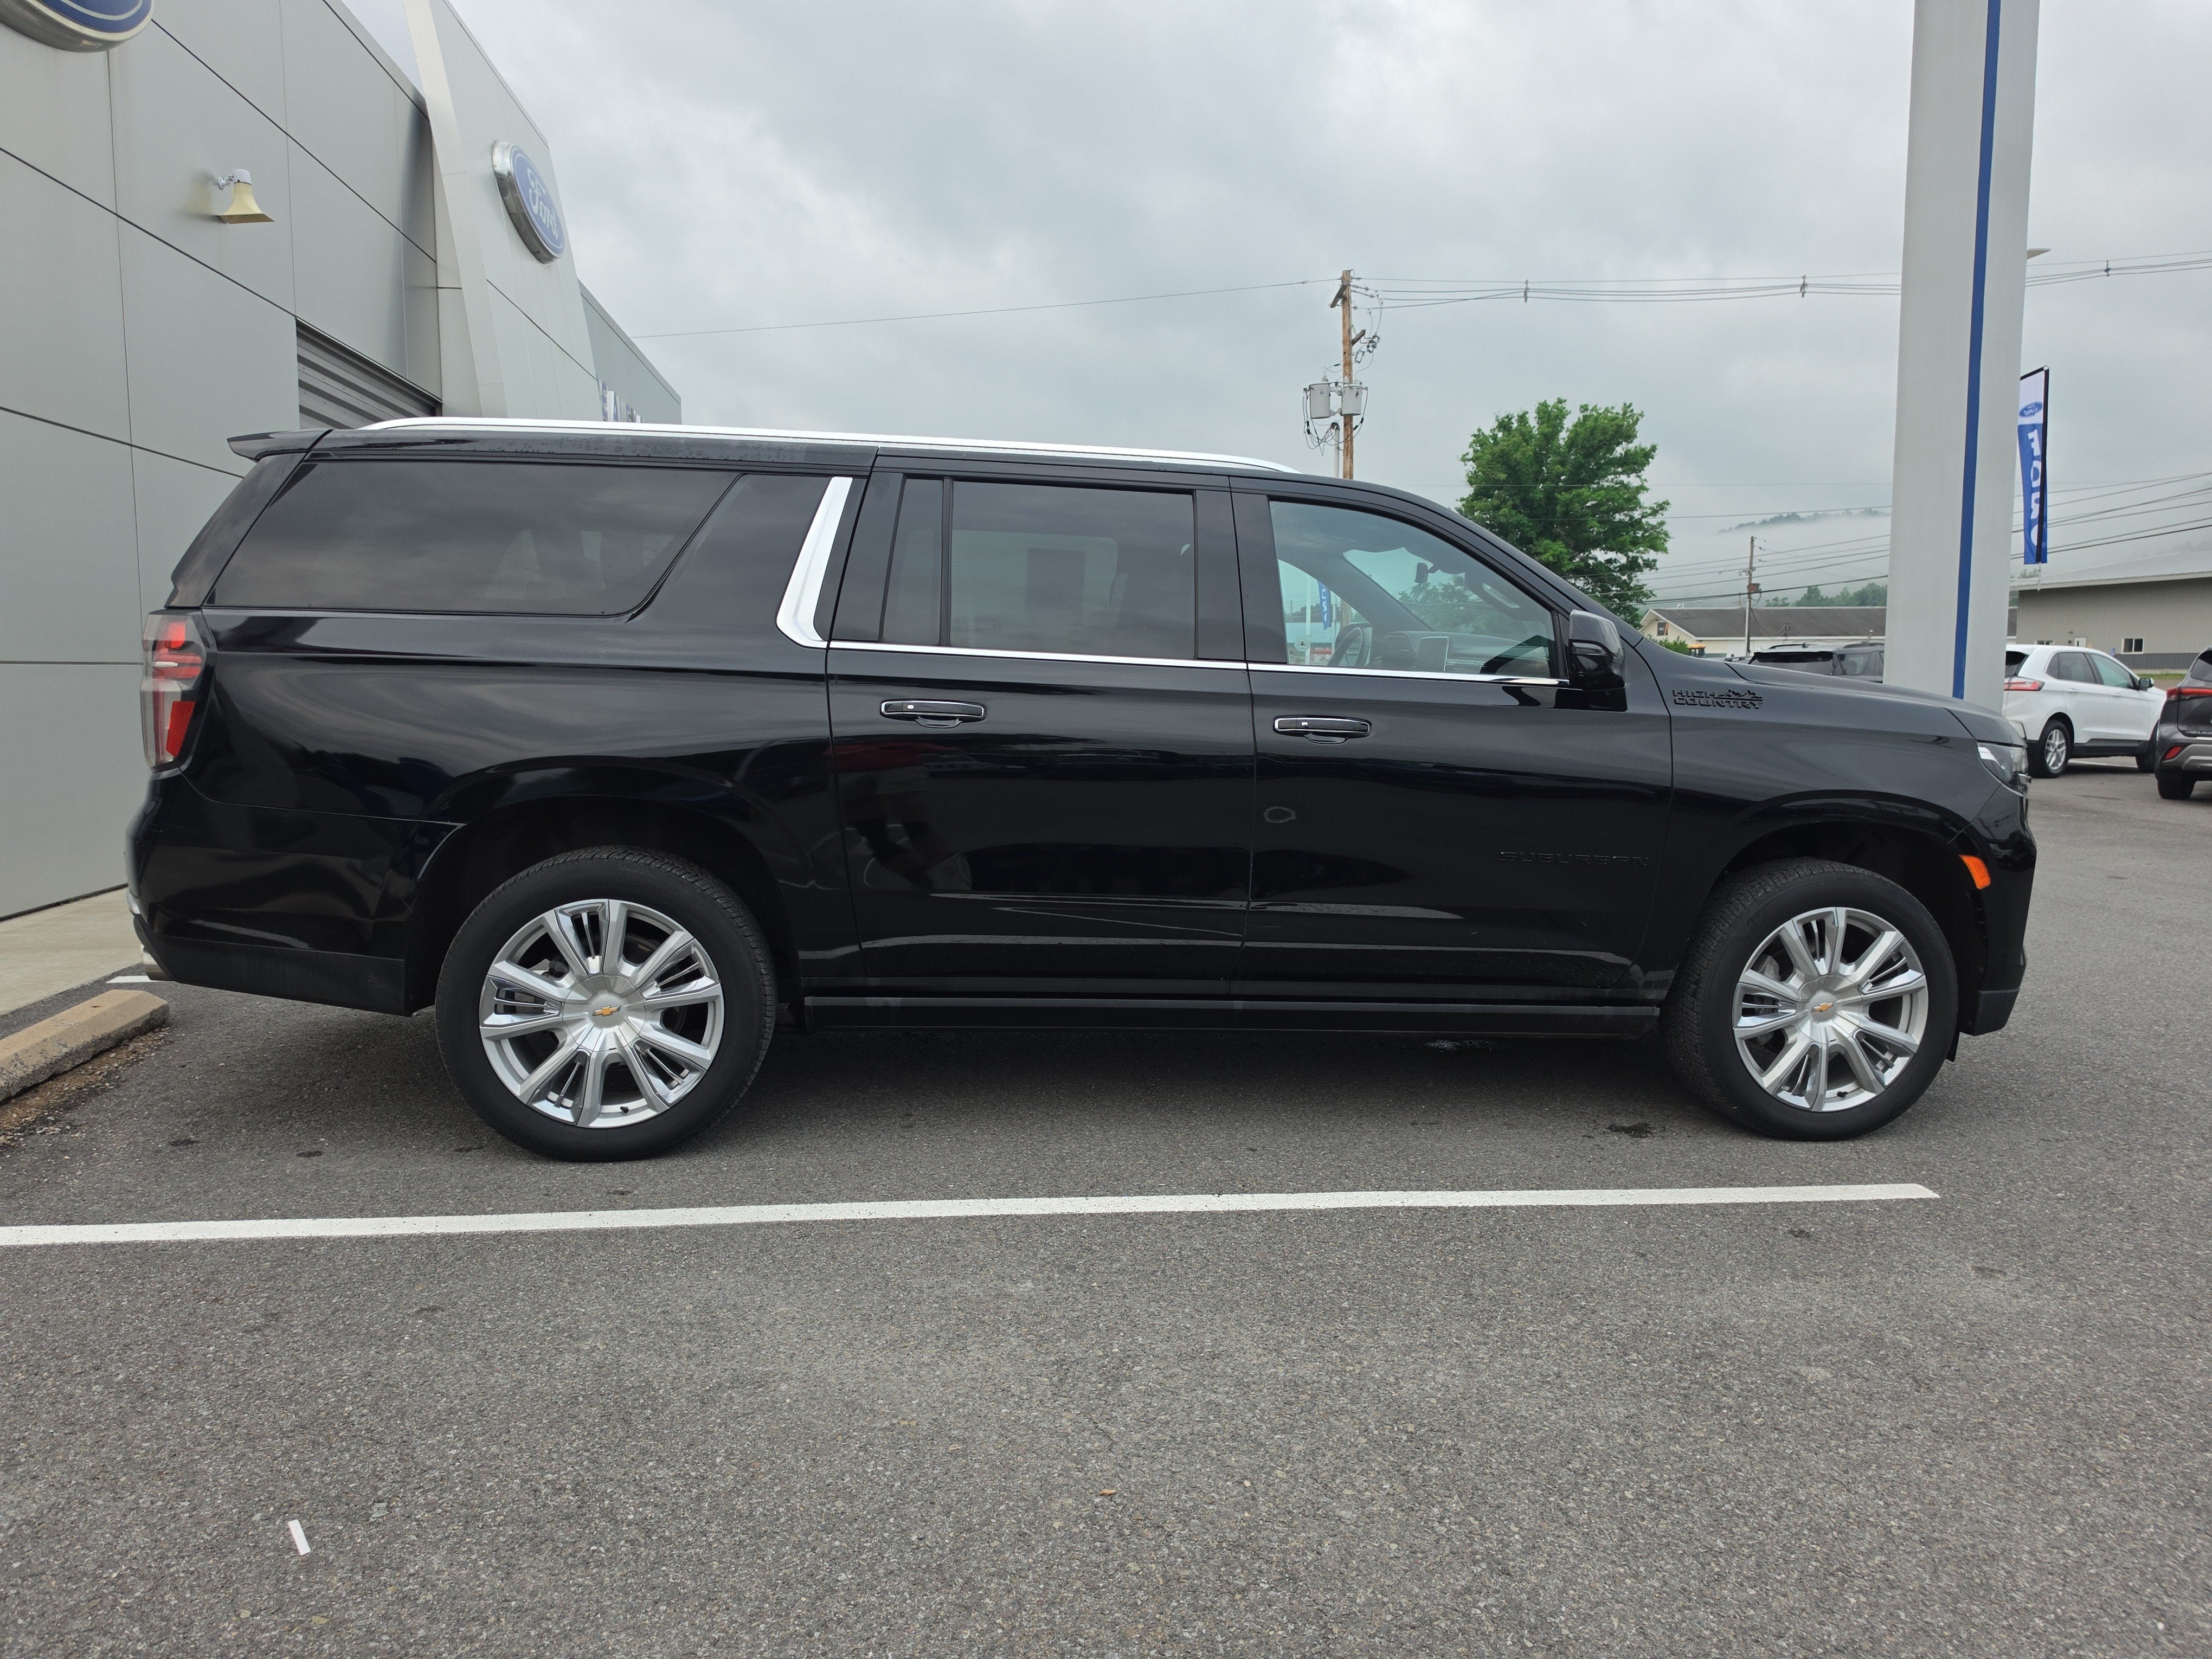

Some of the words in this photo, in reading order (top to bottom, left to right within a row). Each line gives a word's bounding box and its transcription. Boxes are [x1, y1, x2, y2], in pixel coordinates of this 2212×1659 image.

[528, 169, 558, 240] Ford
[1673, 689, 1715, 698] HIGH
[1673, 698, 1763, 709] COUNTRY
[1500, 852, 1650, 867] SUBURBAN
